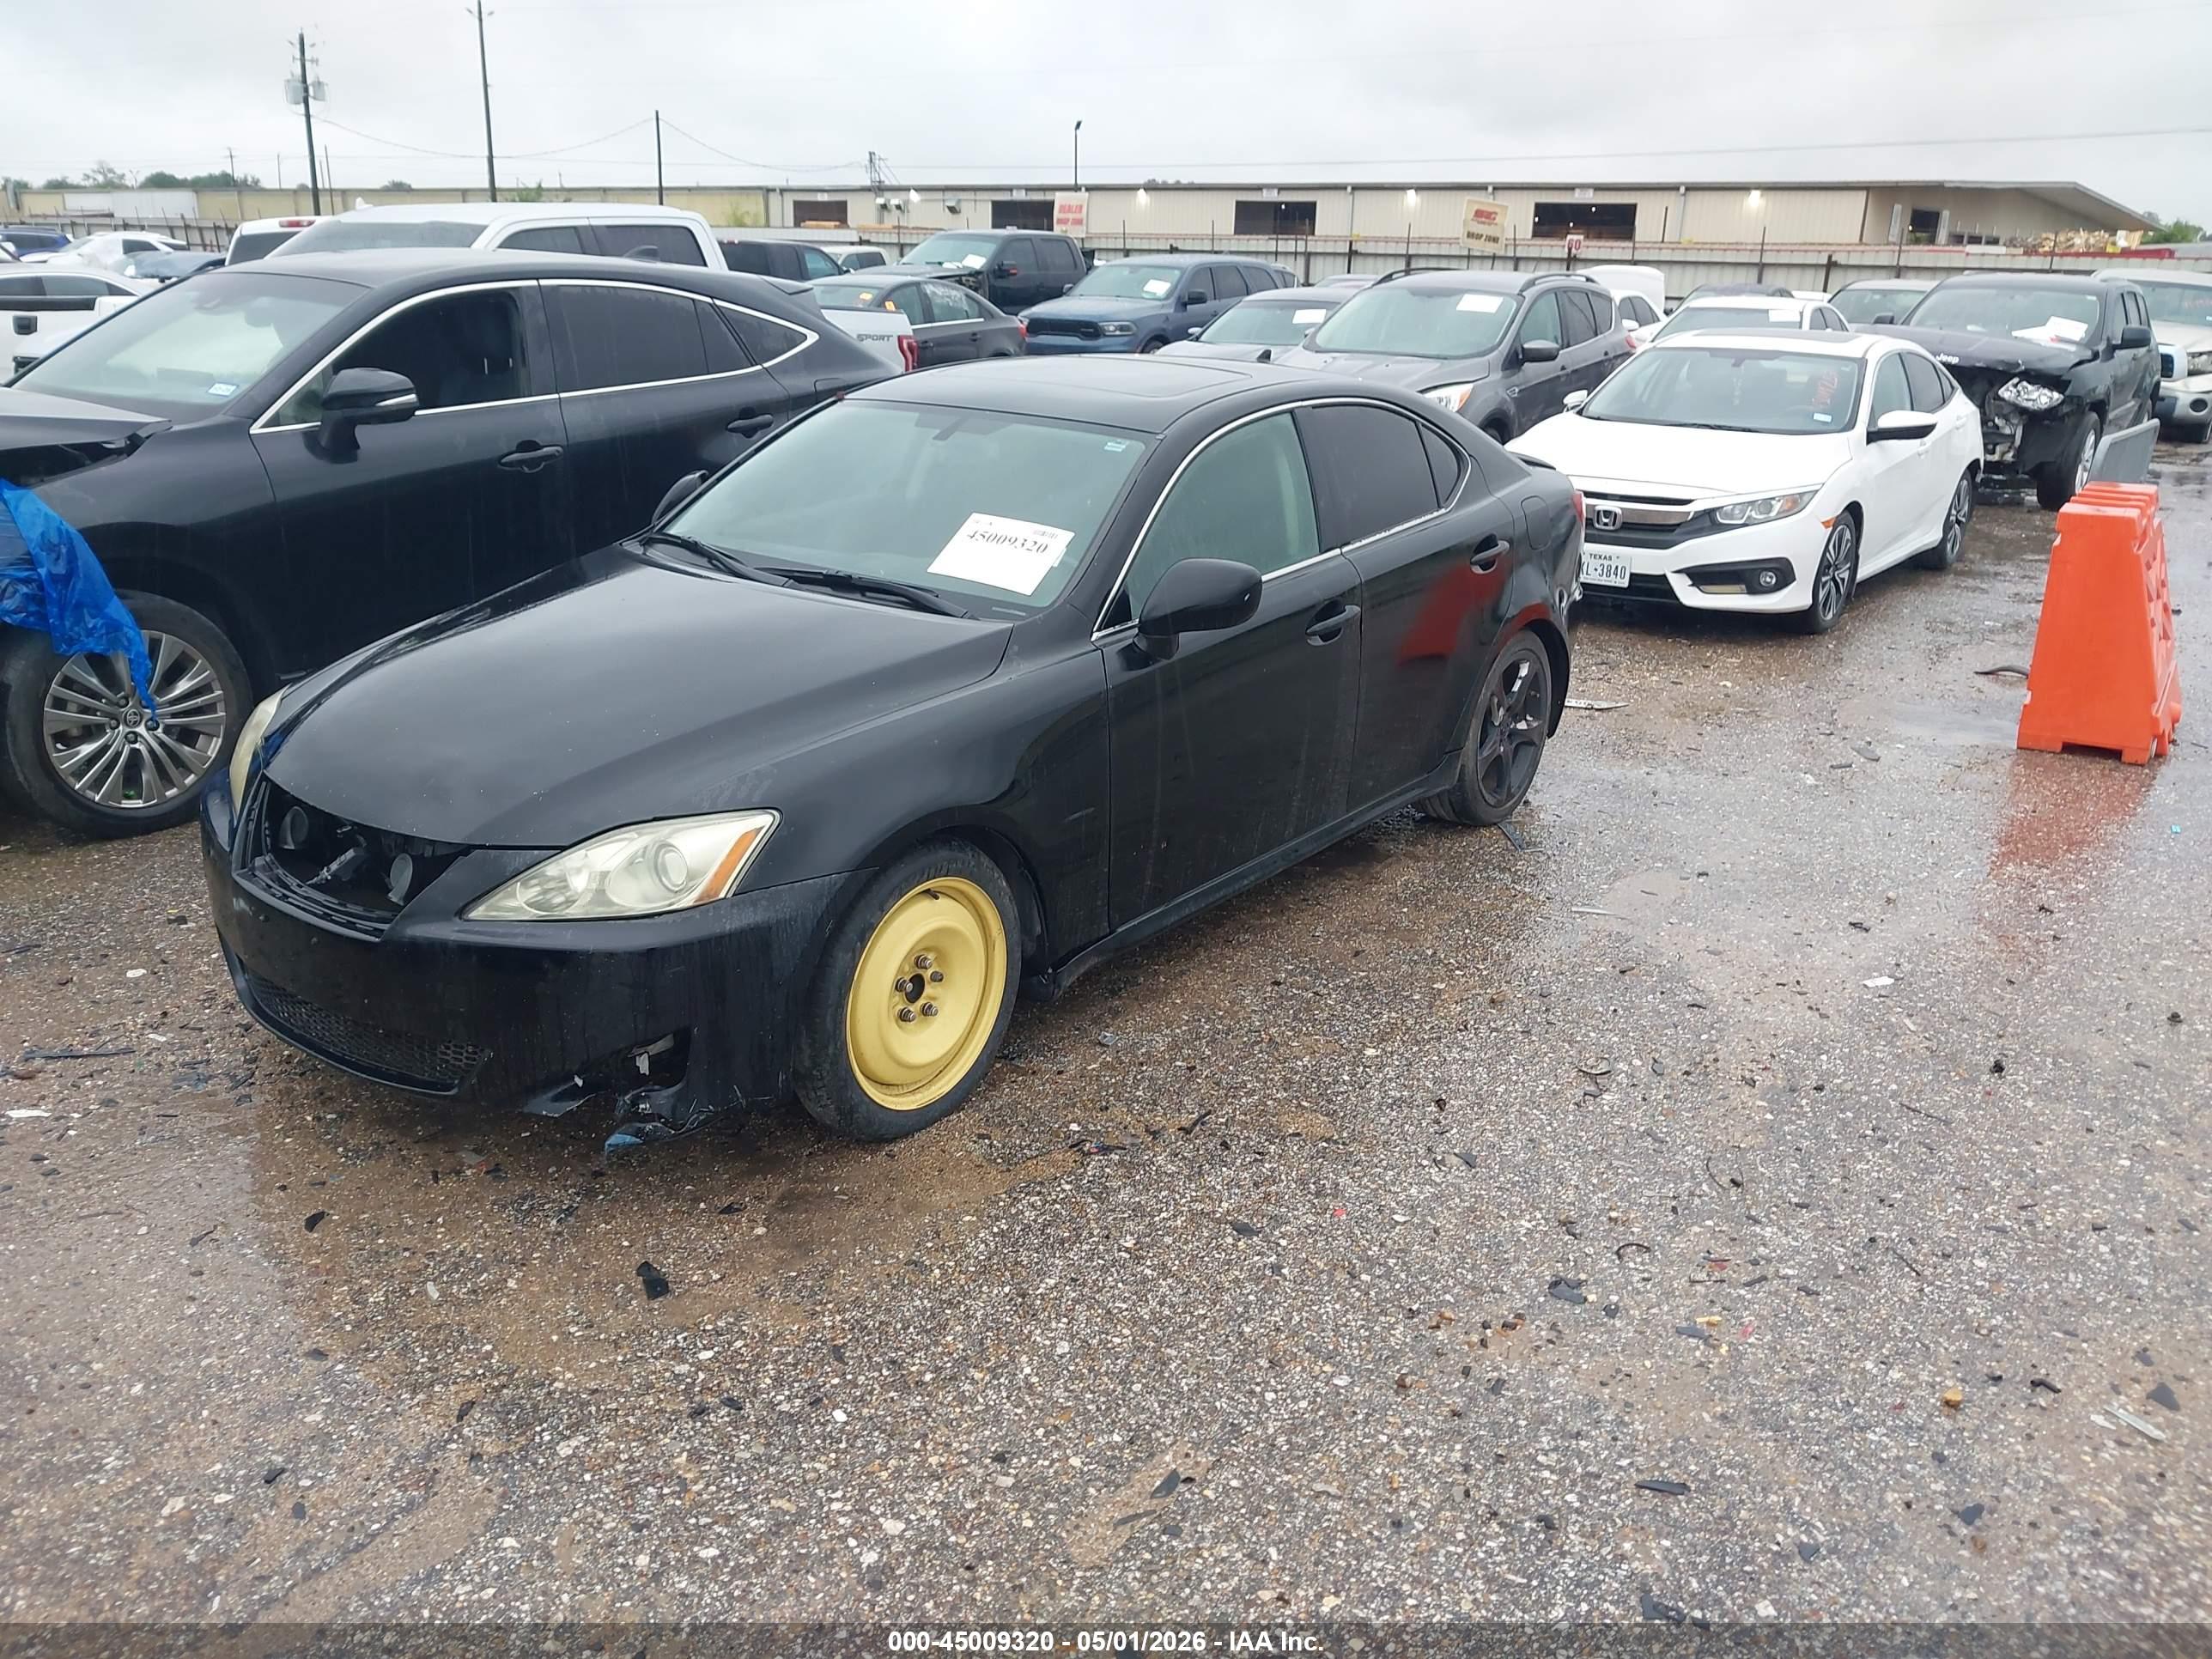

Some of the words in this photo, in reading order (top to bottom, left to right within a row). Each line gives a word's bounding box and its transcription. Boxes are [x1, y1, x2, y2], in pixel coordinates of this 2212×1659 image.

[1467, 231, 1484, 240] DROP
[1484, 234, 1499, 244] ZONE
[857, 333, 894, 342] SPORT
[1936, 352, 1960, 364] Jeep
[967, 530, 1048, 554] 45009320
